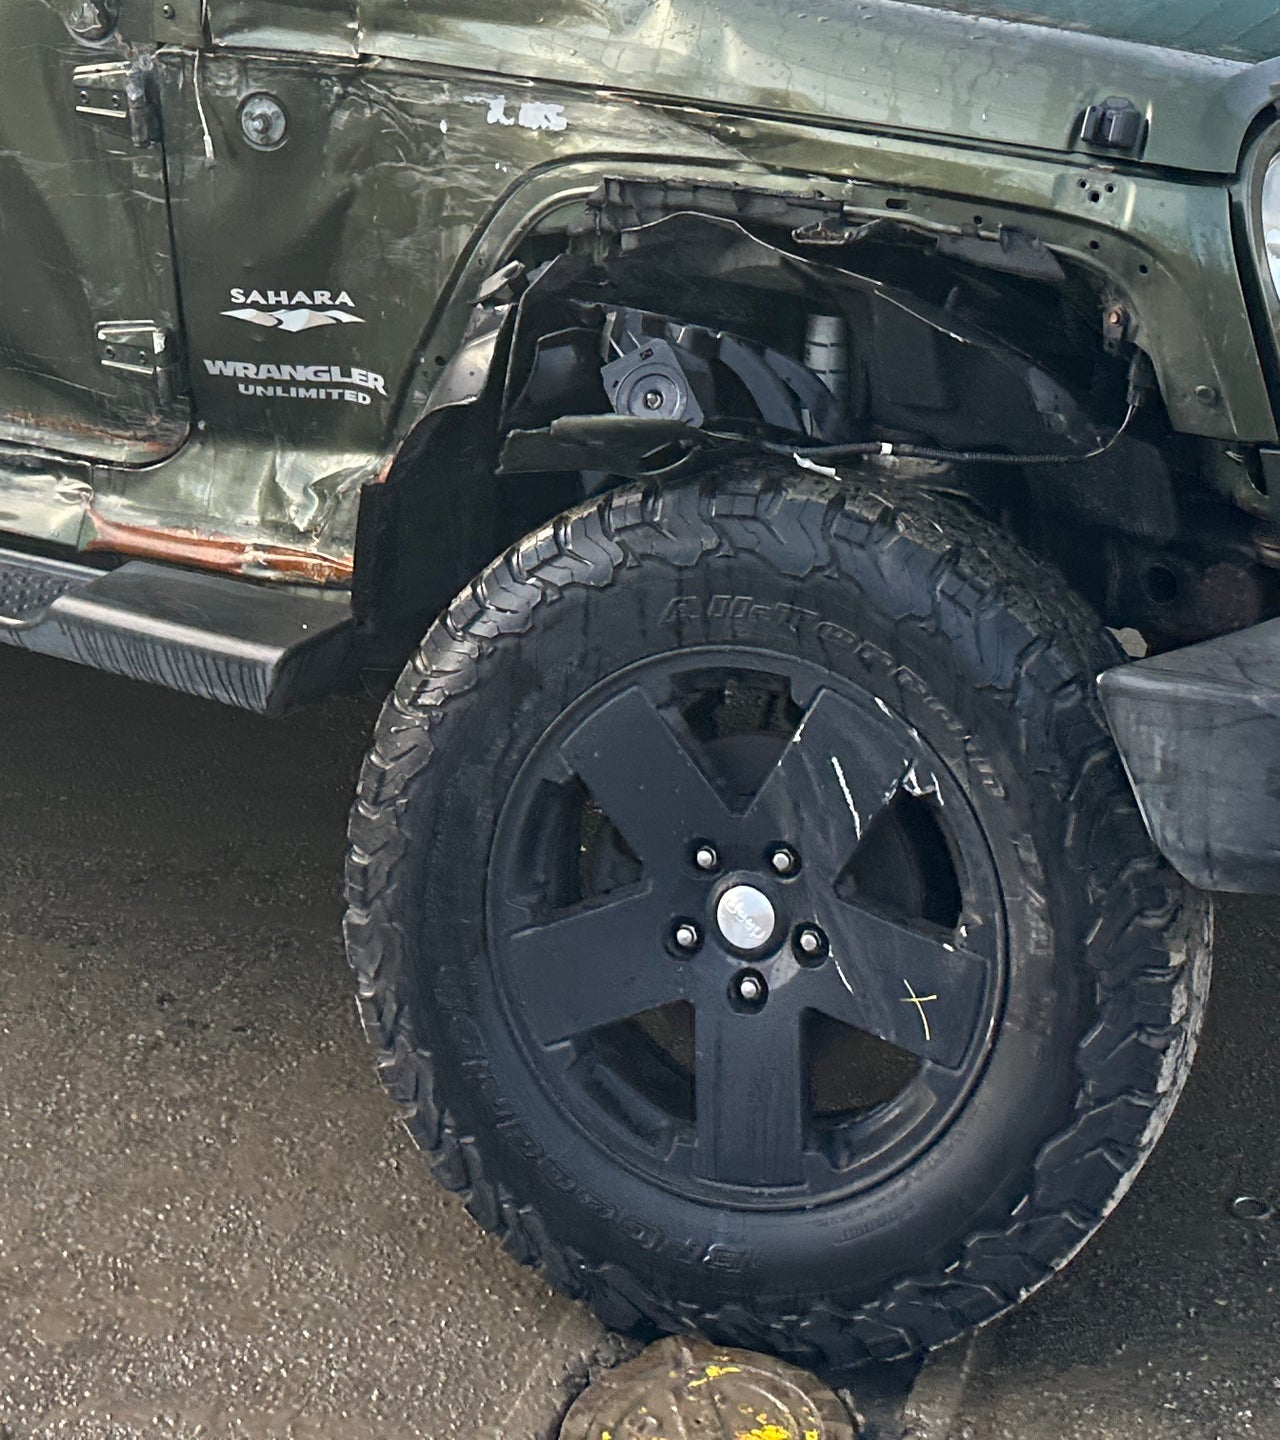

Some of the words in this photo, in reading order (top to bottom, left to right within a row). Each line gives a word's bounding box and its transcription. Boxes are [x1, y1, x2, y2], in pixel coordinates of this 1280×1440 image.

[230, 288, 356, 307] SAHARA
[203, 359, 389, 397] WRANGLER
[238, 383, 371, 406] UNLIMITED
